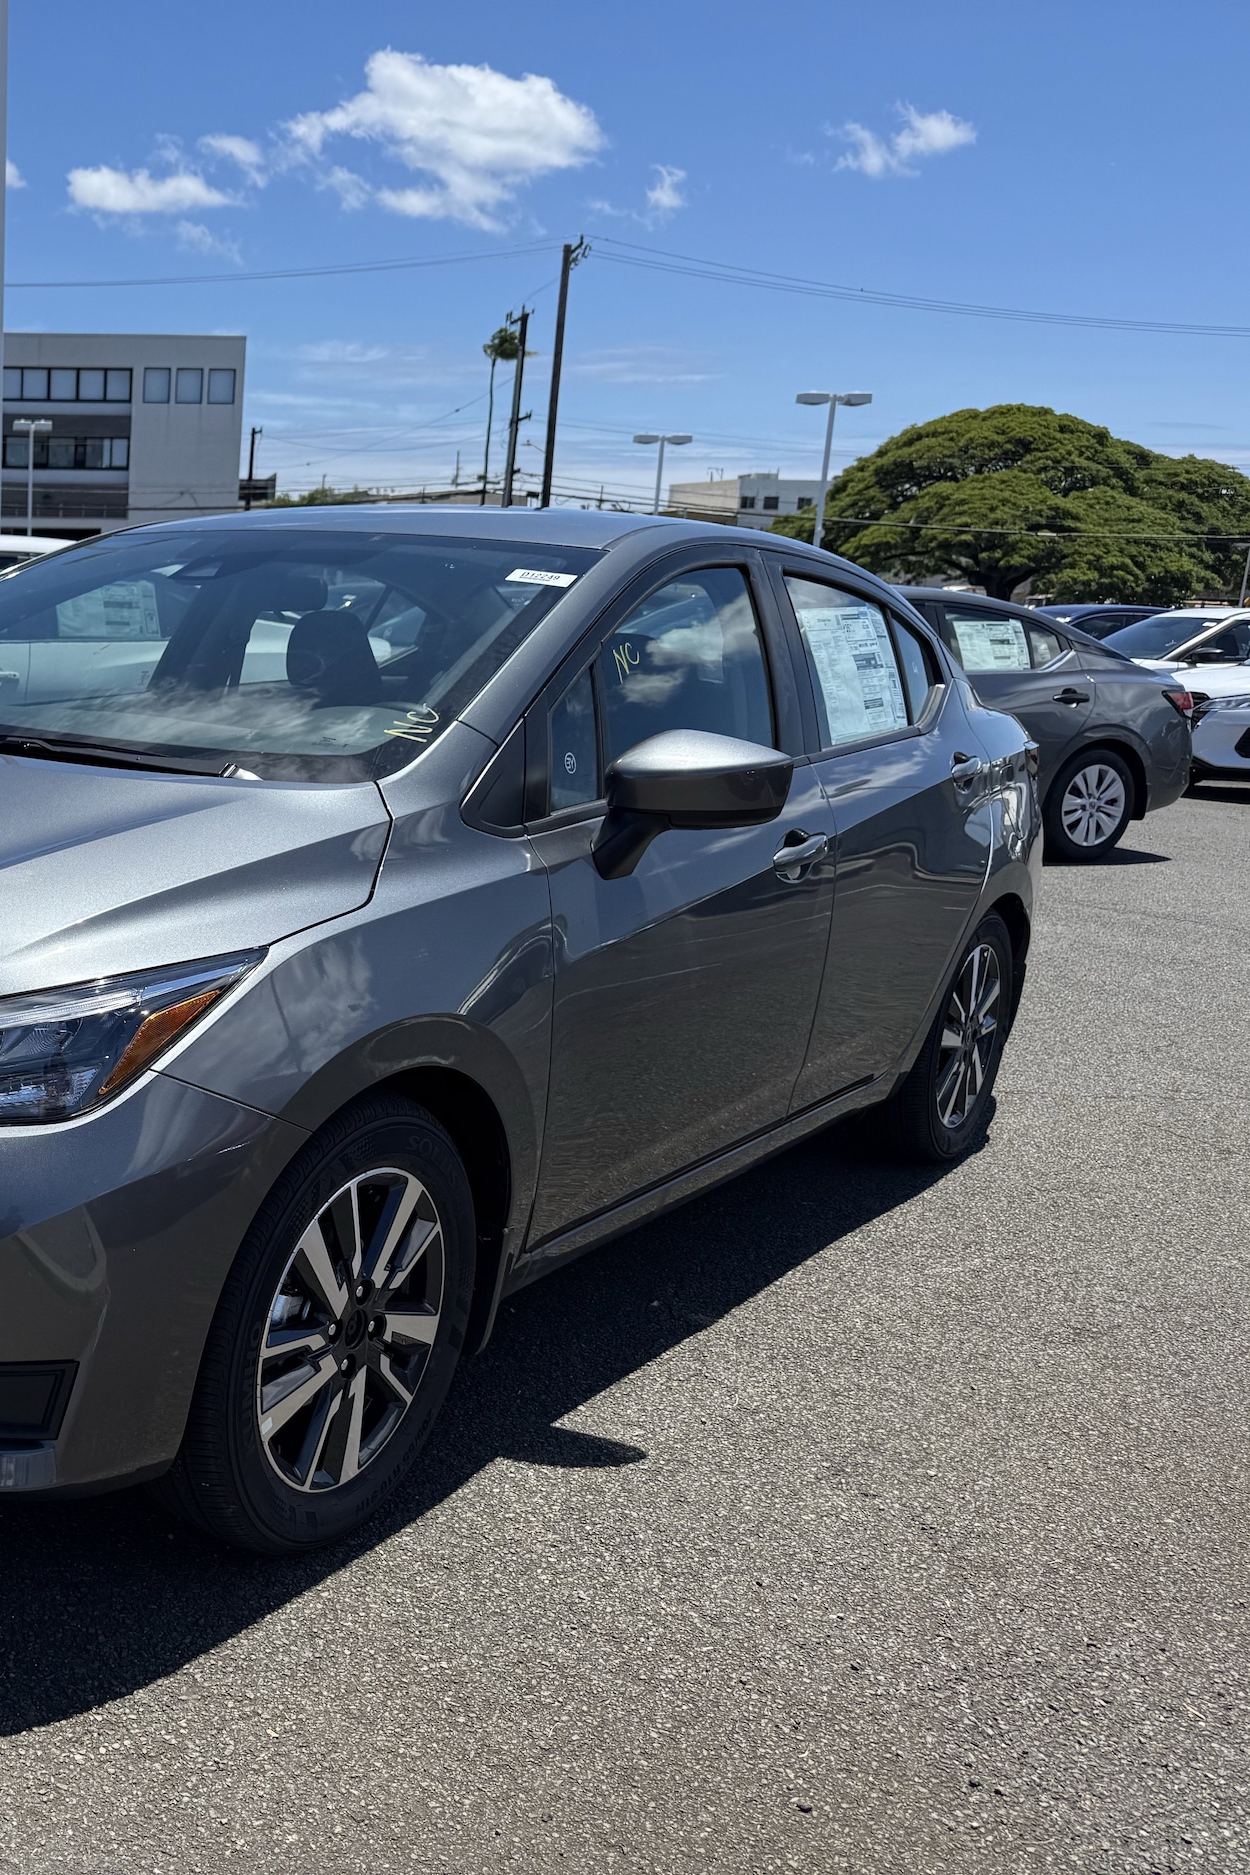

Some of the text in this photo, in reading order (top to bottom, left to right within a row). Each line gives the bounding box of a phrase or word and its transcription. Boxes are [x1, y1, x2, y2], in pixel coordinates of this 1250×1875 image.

[521, 571, 561, 580] D12249
[612, 641, 640, 684] NC
[383, 703, 439, 742] NC
[238, 1320, 262, 1457] KUMHO
